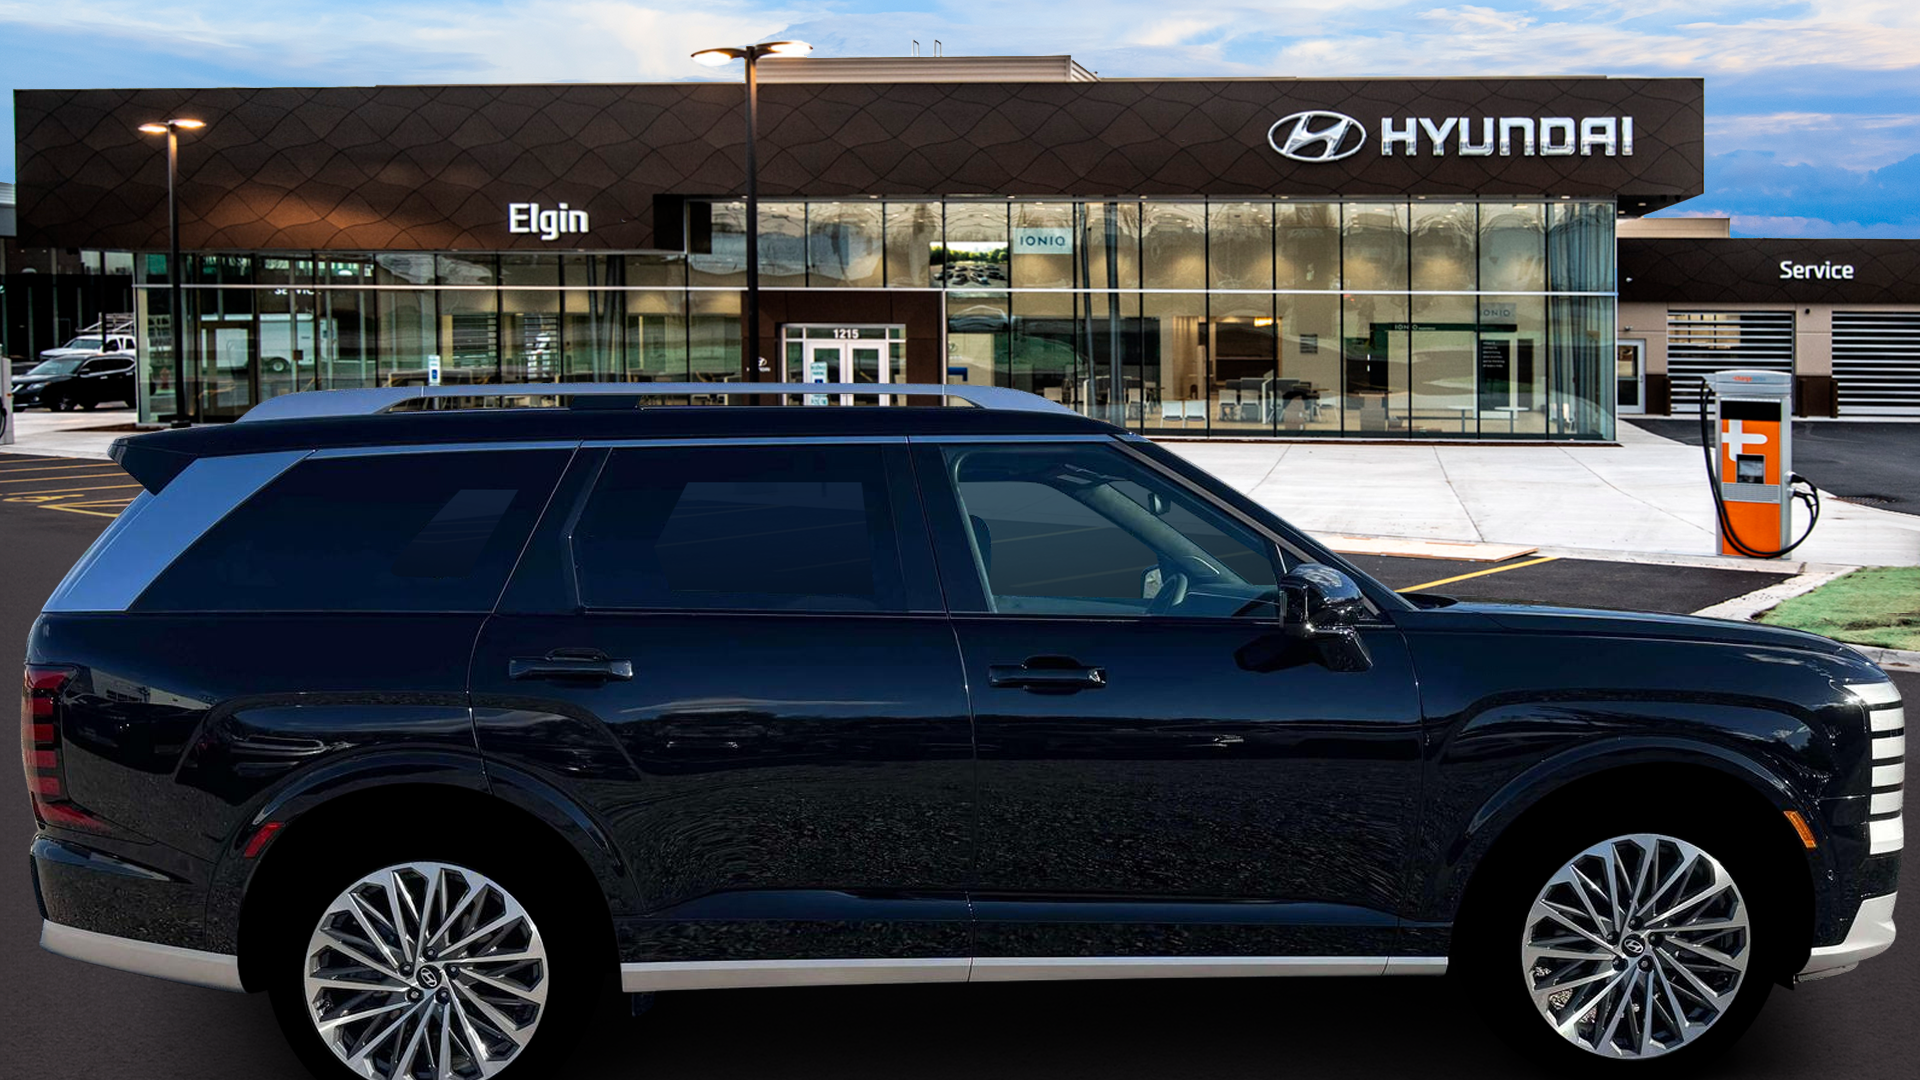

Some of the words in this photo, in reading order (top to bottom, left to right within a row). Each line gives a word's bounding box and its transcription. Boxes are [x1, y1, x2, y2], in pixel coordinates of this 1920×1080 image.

[1381, 116, 1633, 157] HYUNDAI
[508, 202, 590, 241] Elgin
[1020, 235, 1066, 246] IONIQ
[1779, 260, 1855, 279] Service
[833, 328, 860, 339] 1215
